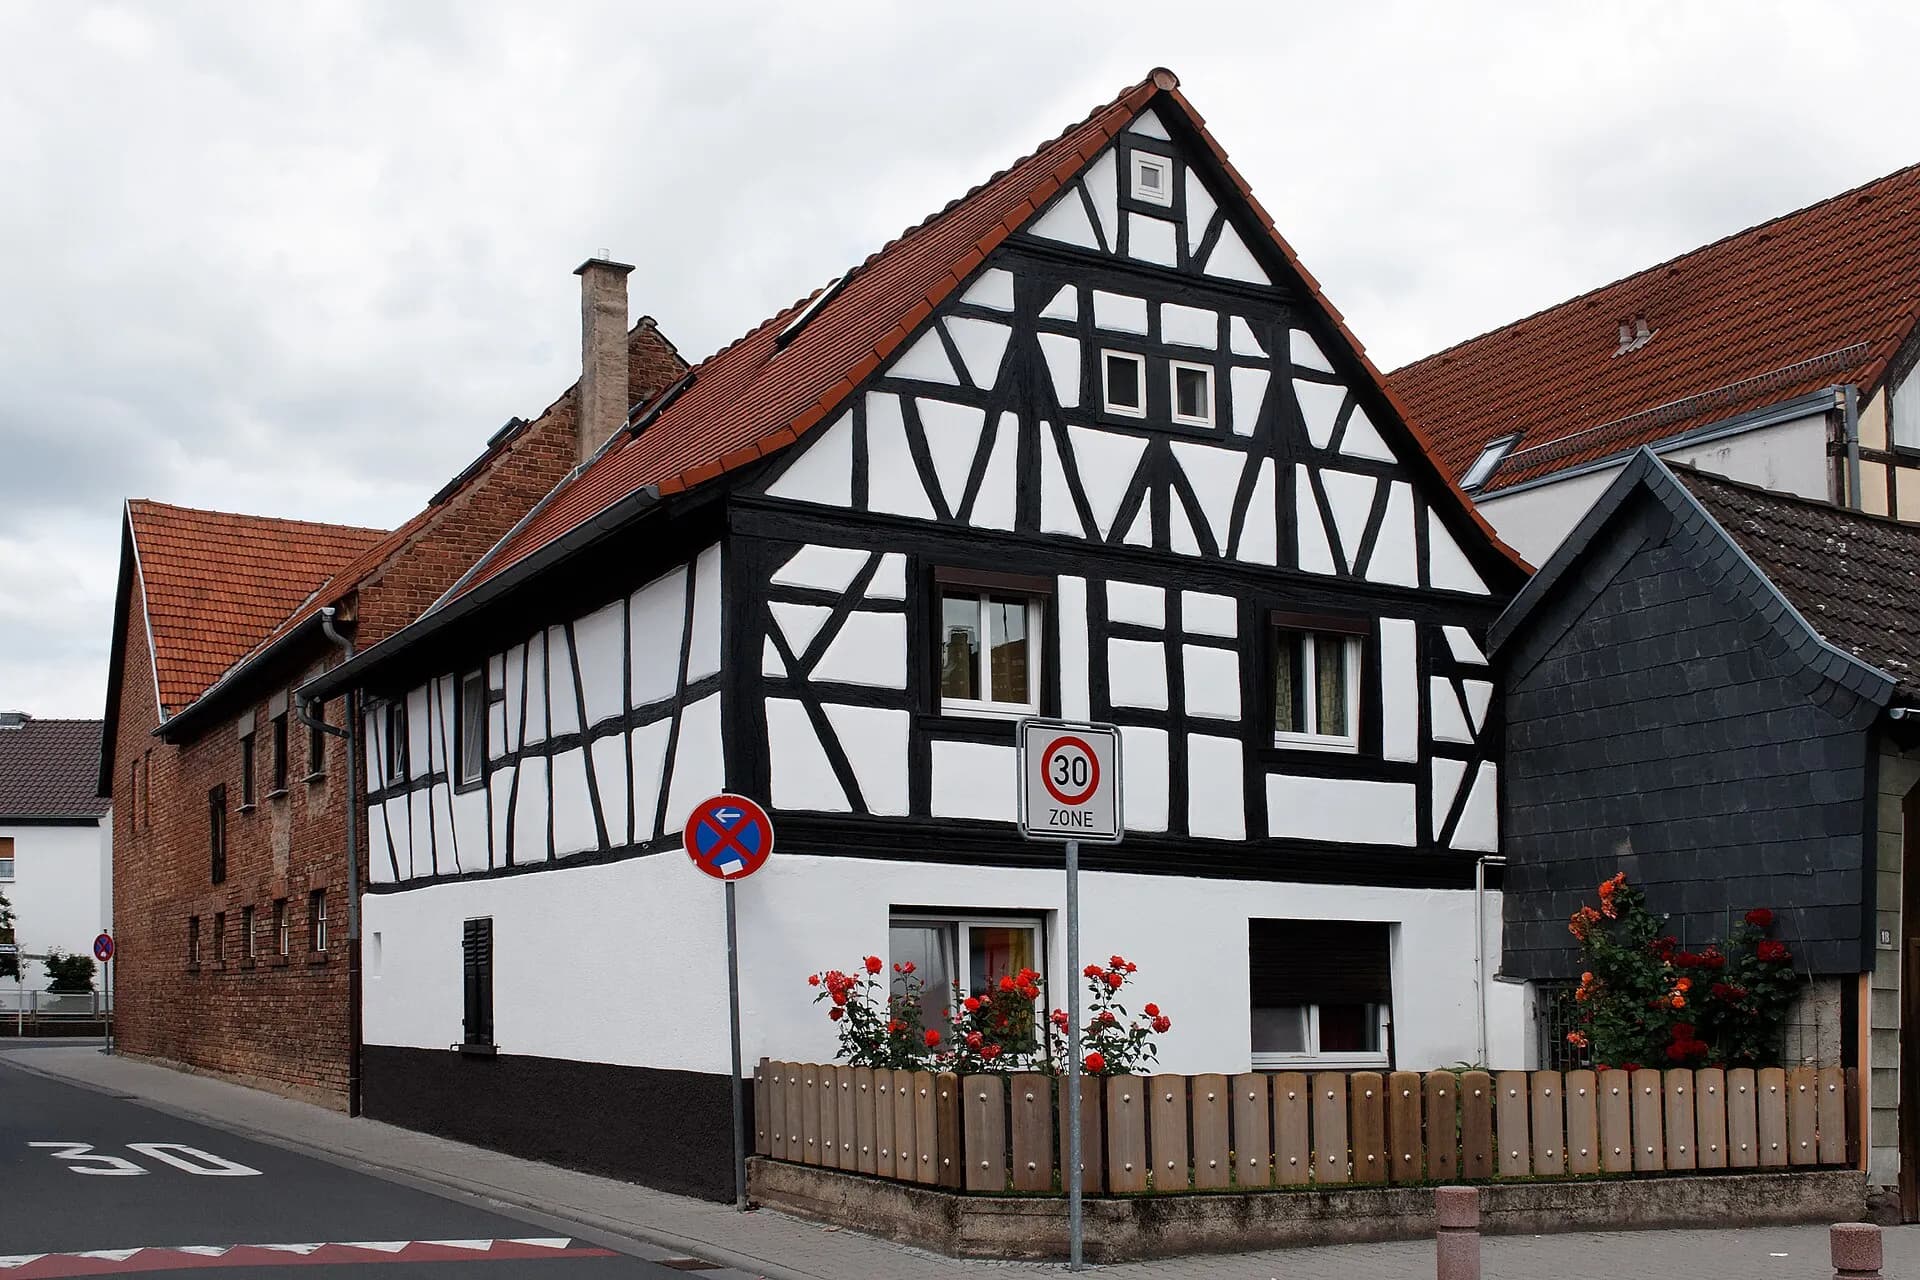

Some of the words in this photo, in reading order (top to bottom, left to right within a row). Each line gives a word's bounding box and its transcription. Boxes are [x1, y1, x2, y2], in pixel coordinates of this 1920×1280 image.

[1053, 754, 1088, 787] 30
[1049, 809, 1093, 827] ZONE
[27, 1141, 264, 1176] 30
